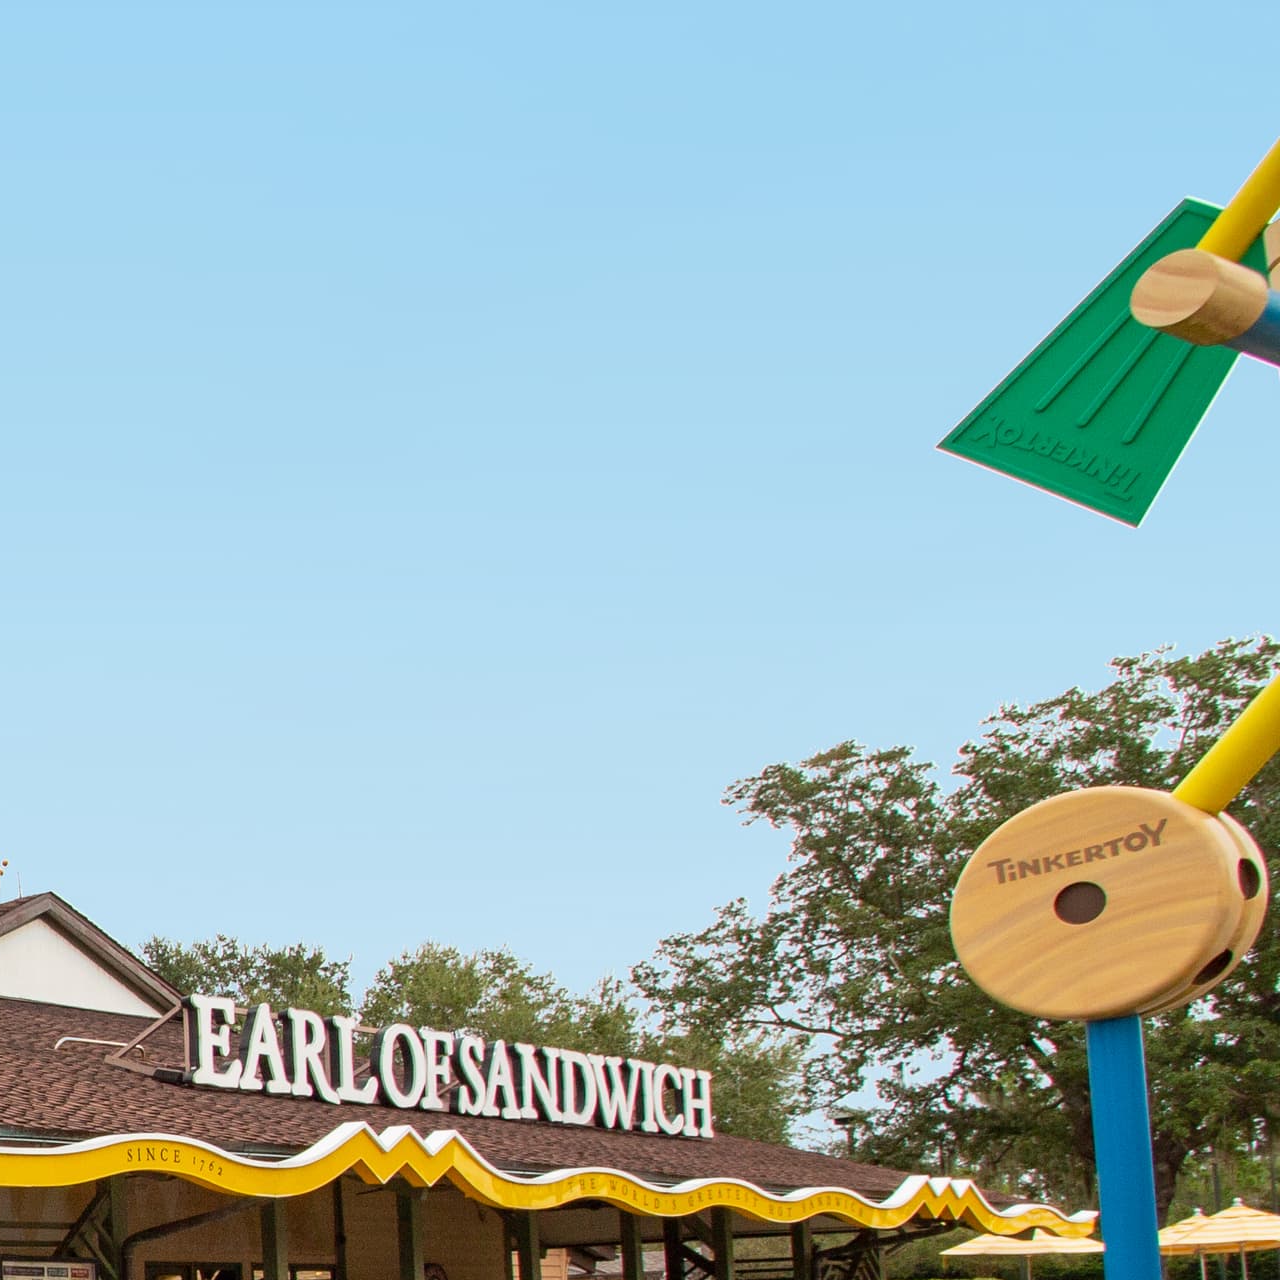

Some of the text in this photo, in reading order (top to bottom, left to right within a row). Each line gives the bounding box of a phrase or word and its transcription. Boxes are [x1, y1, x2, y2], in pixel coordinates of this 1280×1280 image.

[191, 995, 715, 1138] EARL OF SANDWICH
[127, 1147, 223, 1177] SINCE 1762
[568, 1178, 596, 1192] THE
